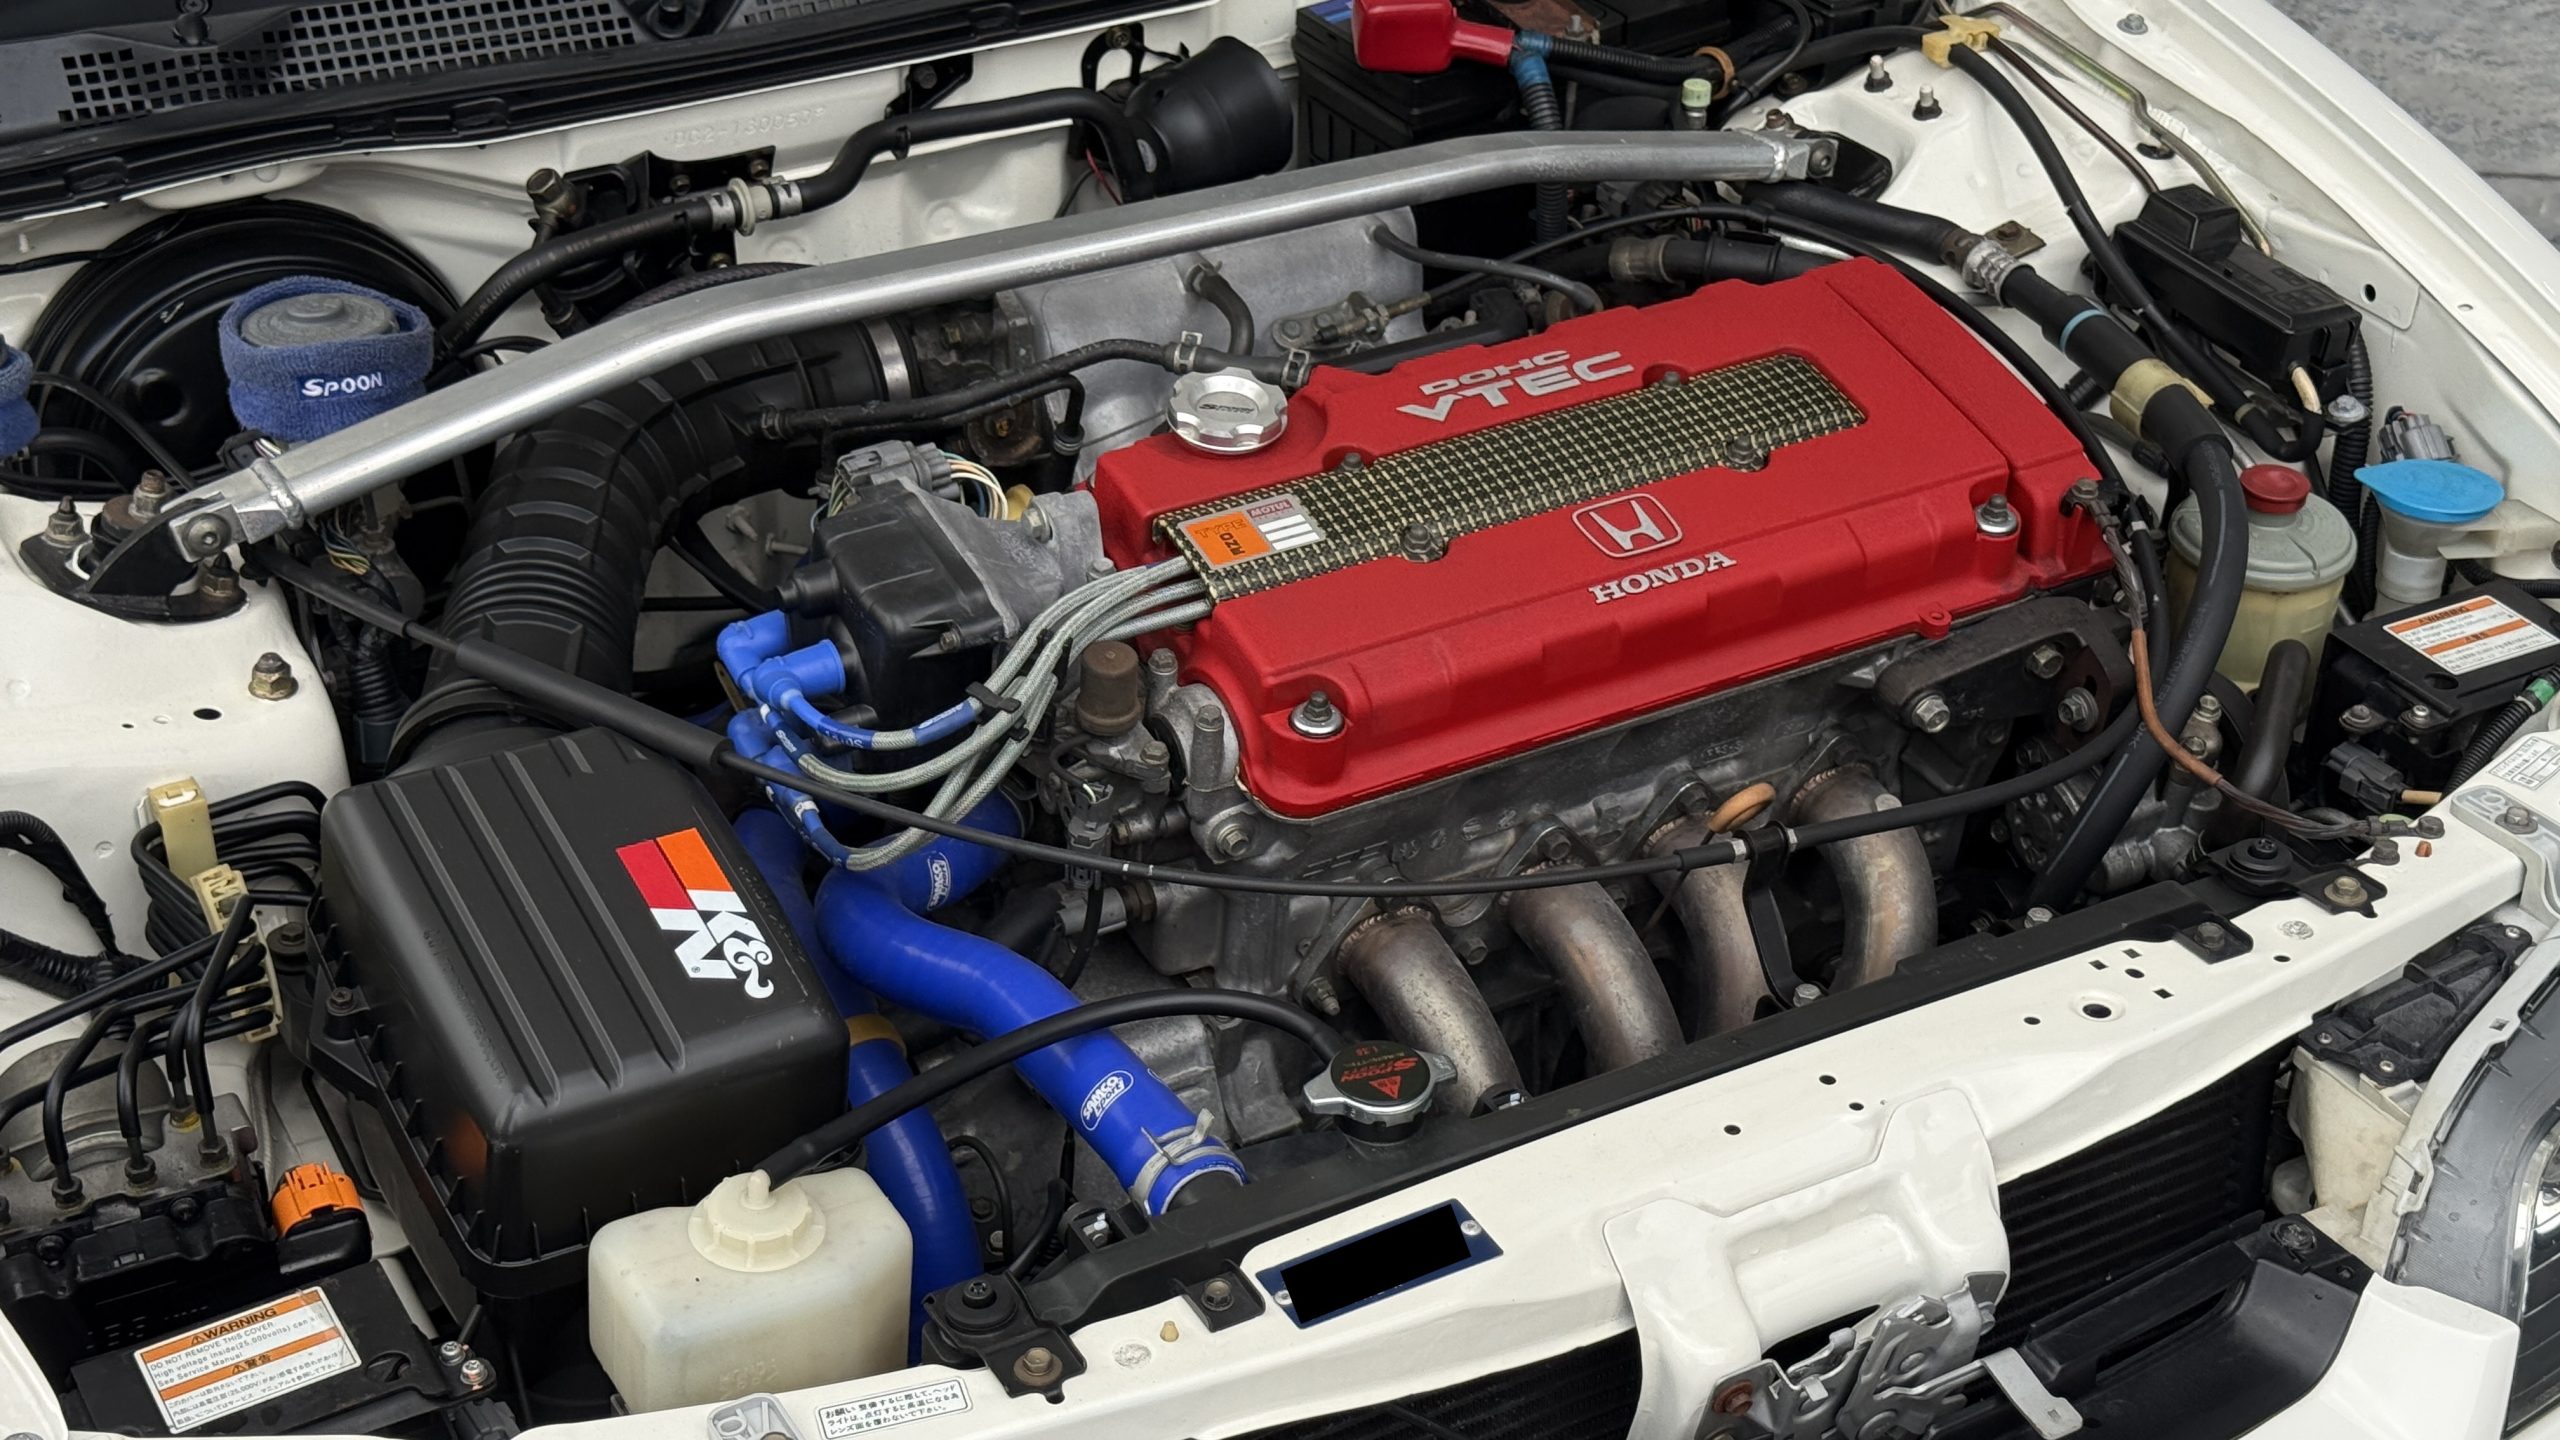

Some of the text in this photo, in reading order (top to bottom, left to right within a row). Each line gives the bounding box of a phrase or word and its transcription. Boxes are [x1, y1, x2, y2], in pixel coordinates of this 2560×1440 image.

[302, 371, 383, 397] SPOON
[1395, 351, 1635, 422] VTEC
[1419, 350, 1570, 396] DOHC
[1249, 500, 1292, 517] MOTUL
[1588, 551, 1737, 604] HONDA
[1083, 1076, 1119, 1121] SAMCO
[177, 1355, 208, 1372] voltage
[292, 1319, 308, 1329] can
[203, 1308, 277, 1339] WARNING
[150, 1321, 274, 1372] DO NOT REMOVE THIS COVER
[157, 1352, 242, 1388] See Service Manual
